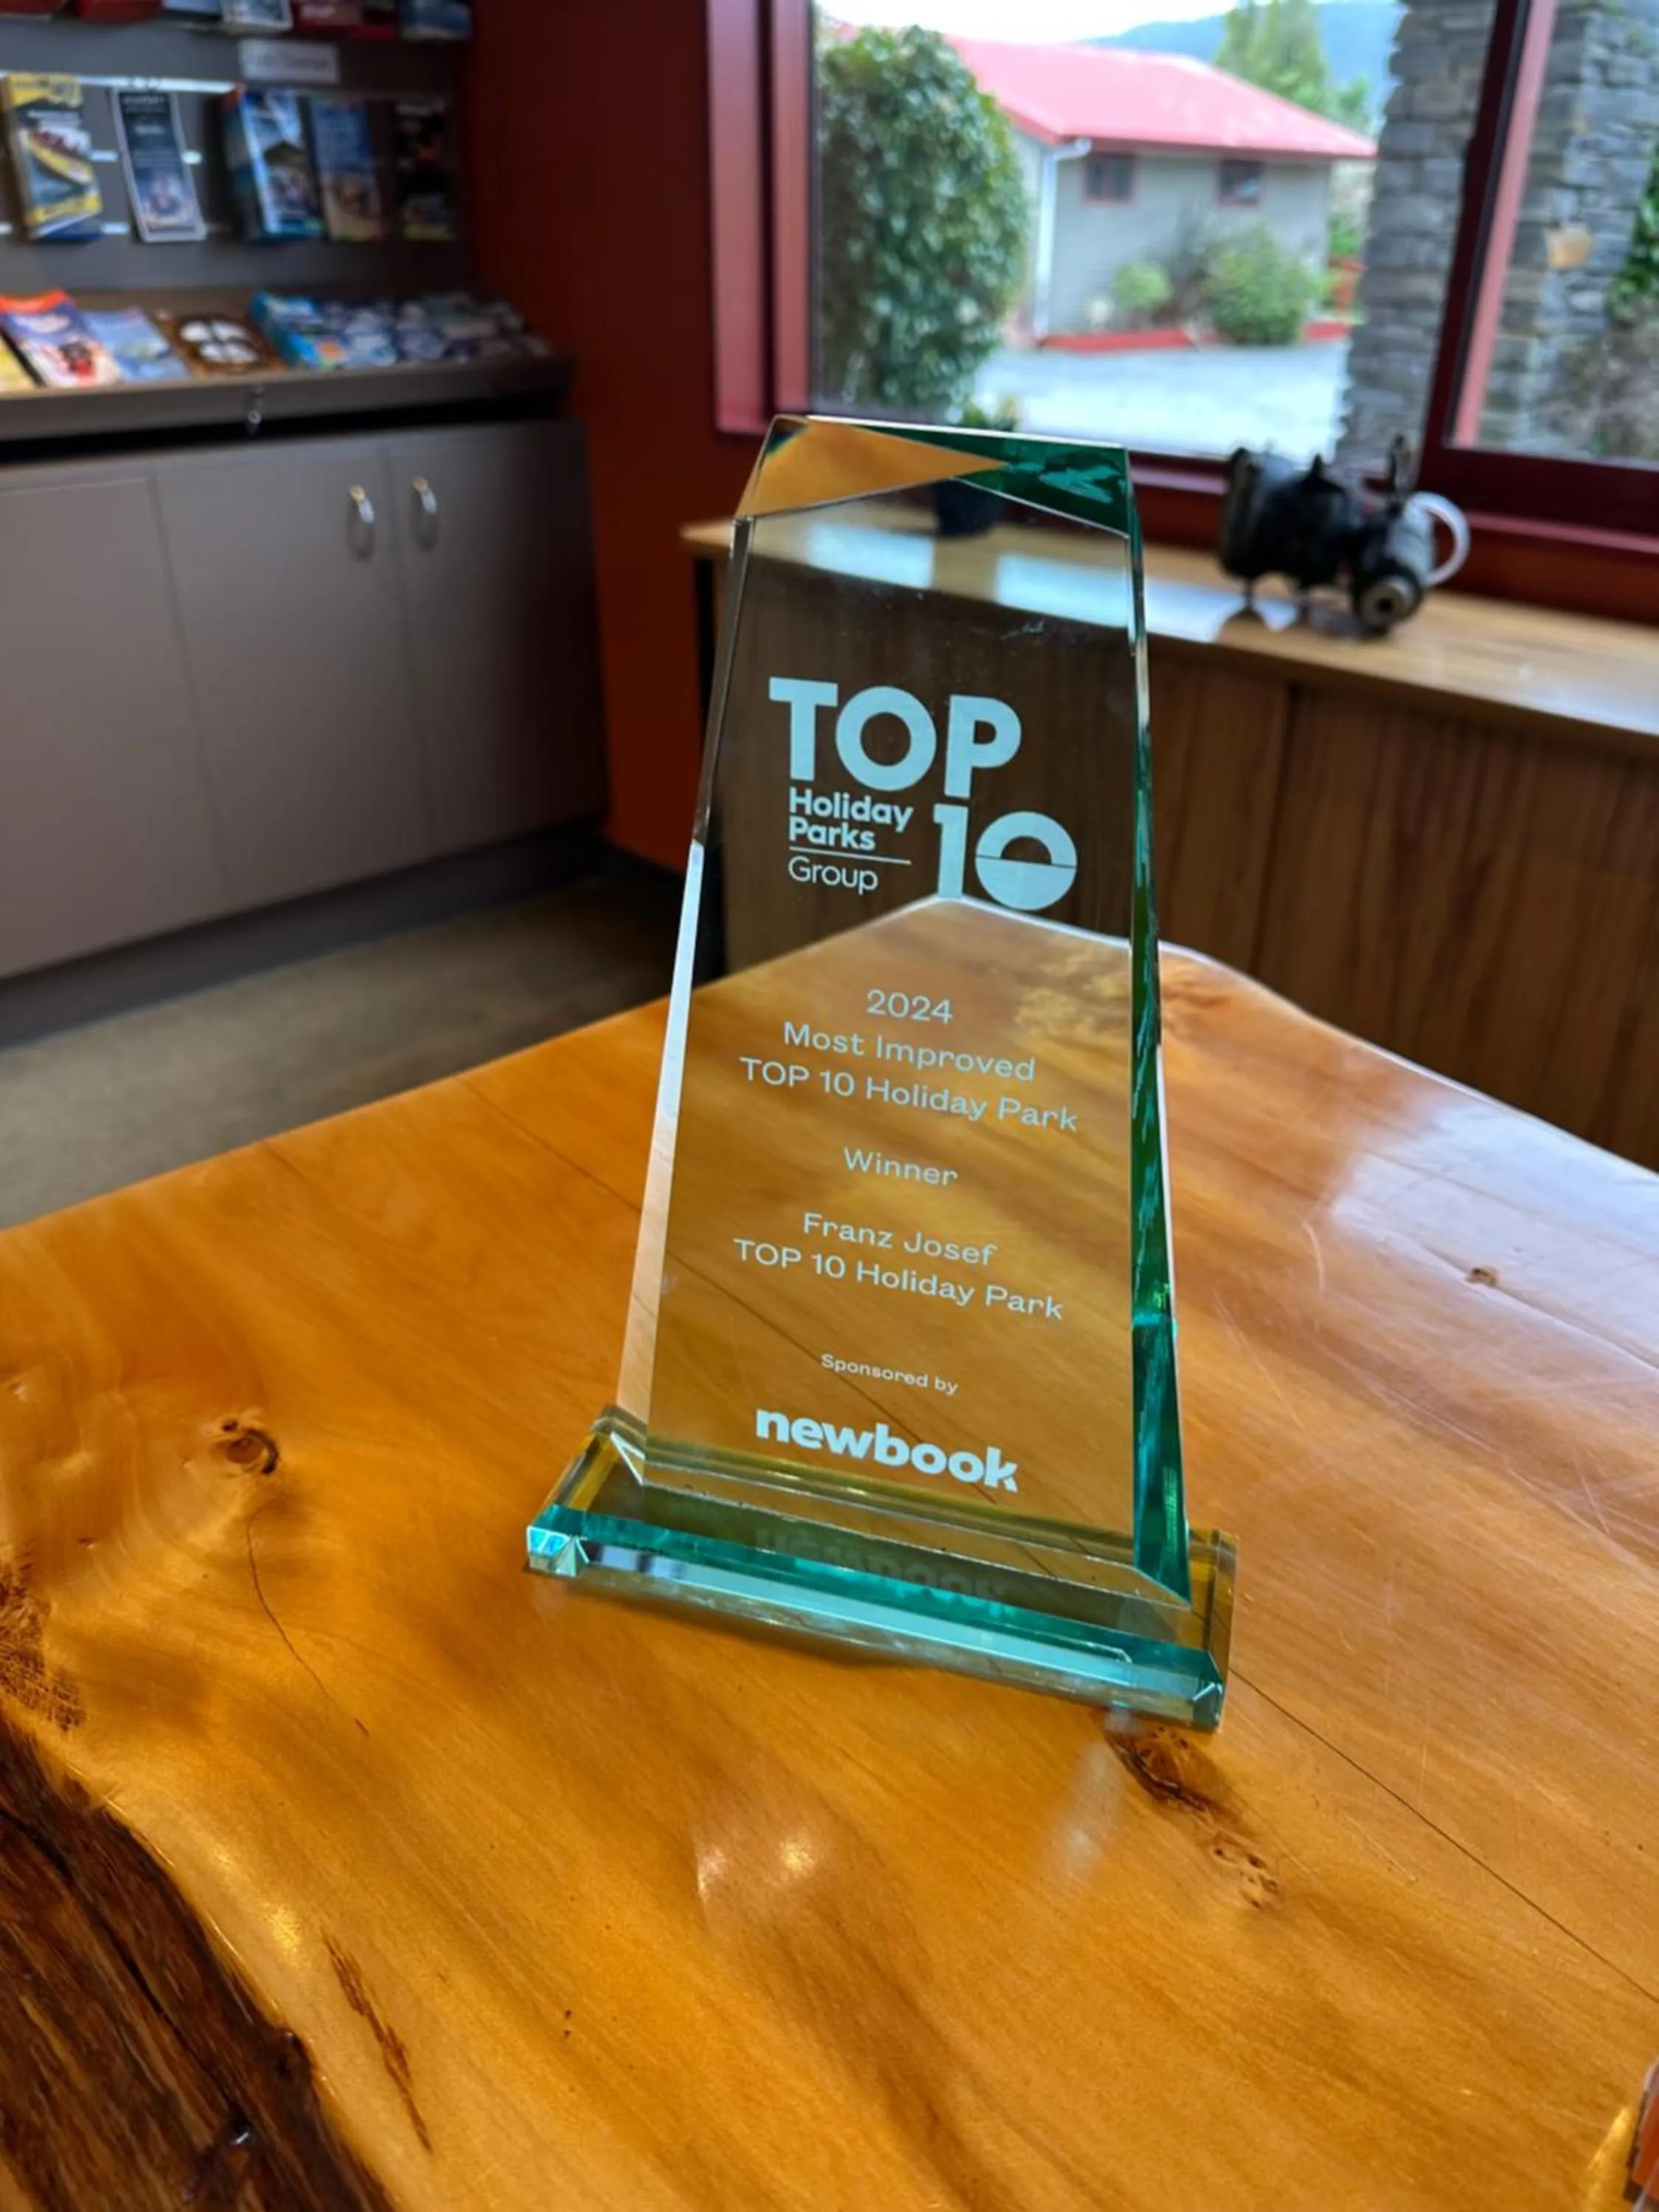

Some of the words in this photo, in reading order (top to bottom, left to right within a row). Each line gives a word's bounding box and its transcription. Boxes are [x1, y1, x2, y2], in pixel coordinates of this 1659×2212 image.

[769, 676, 1022, 799] TOP
[789, 787, 914, 833] Holiday
[789, 815, 876, 852] Parks
[788, 856, 878, 895] Group
[933, 803, 1077, 911] 10
[866, 989, 953, 1025] 2024
[783, 1021, 865, 1056] Most
[876, 1036, 1036, 1082] Improved
[739, 1057, 810, 1087] TOP
[819, 1071, 855, 1097] 10
[866, 1077, 988, 1121] Holiday
[998, 1096, 1079, 1132] Park
[844, 1147, 959, 1186] Winner
[803, 1212, 894, 1249] Franz
[903, 1231, 998, 1266] Josef
[733, 1238, 802, 1268] TOP
[812, 1253, 846, 1279] 10
[856, 1261, 975, 1307] Holiday
[984, 1284, 1062, 1321] Park
[821, 1353, 928, 1389] Sponsored
[933, 1375, 959, 1397] by
[755, 1408, 1019, 1493] newbook
